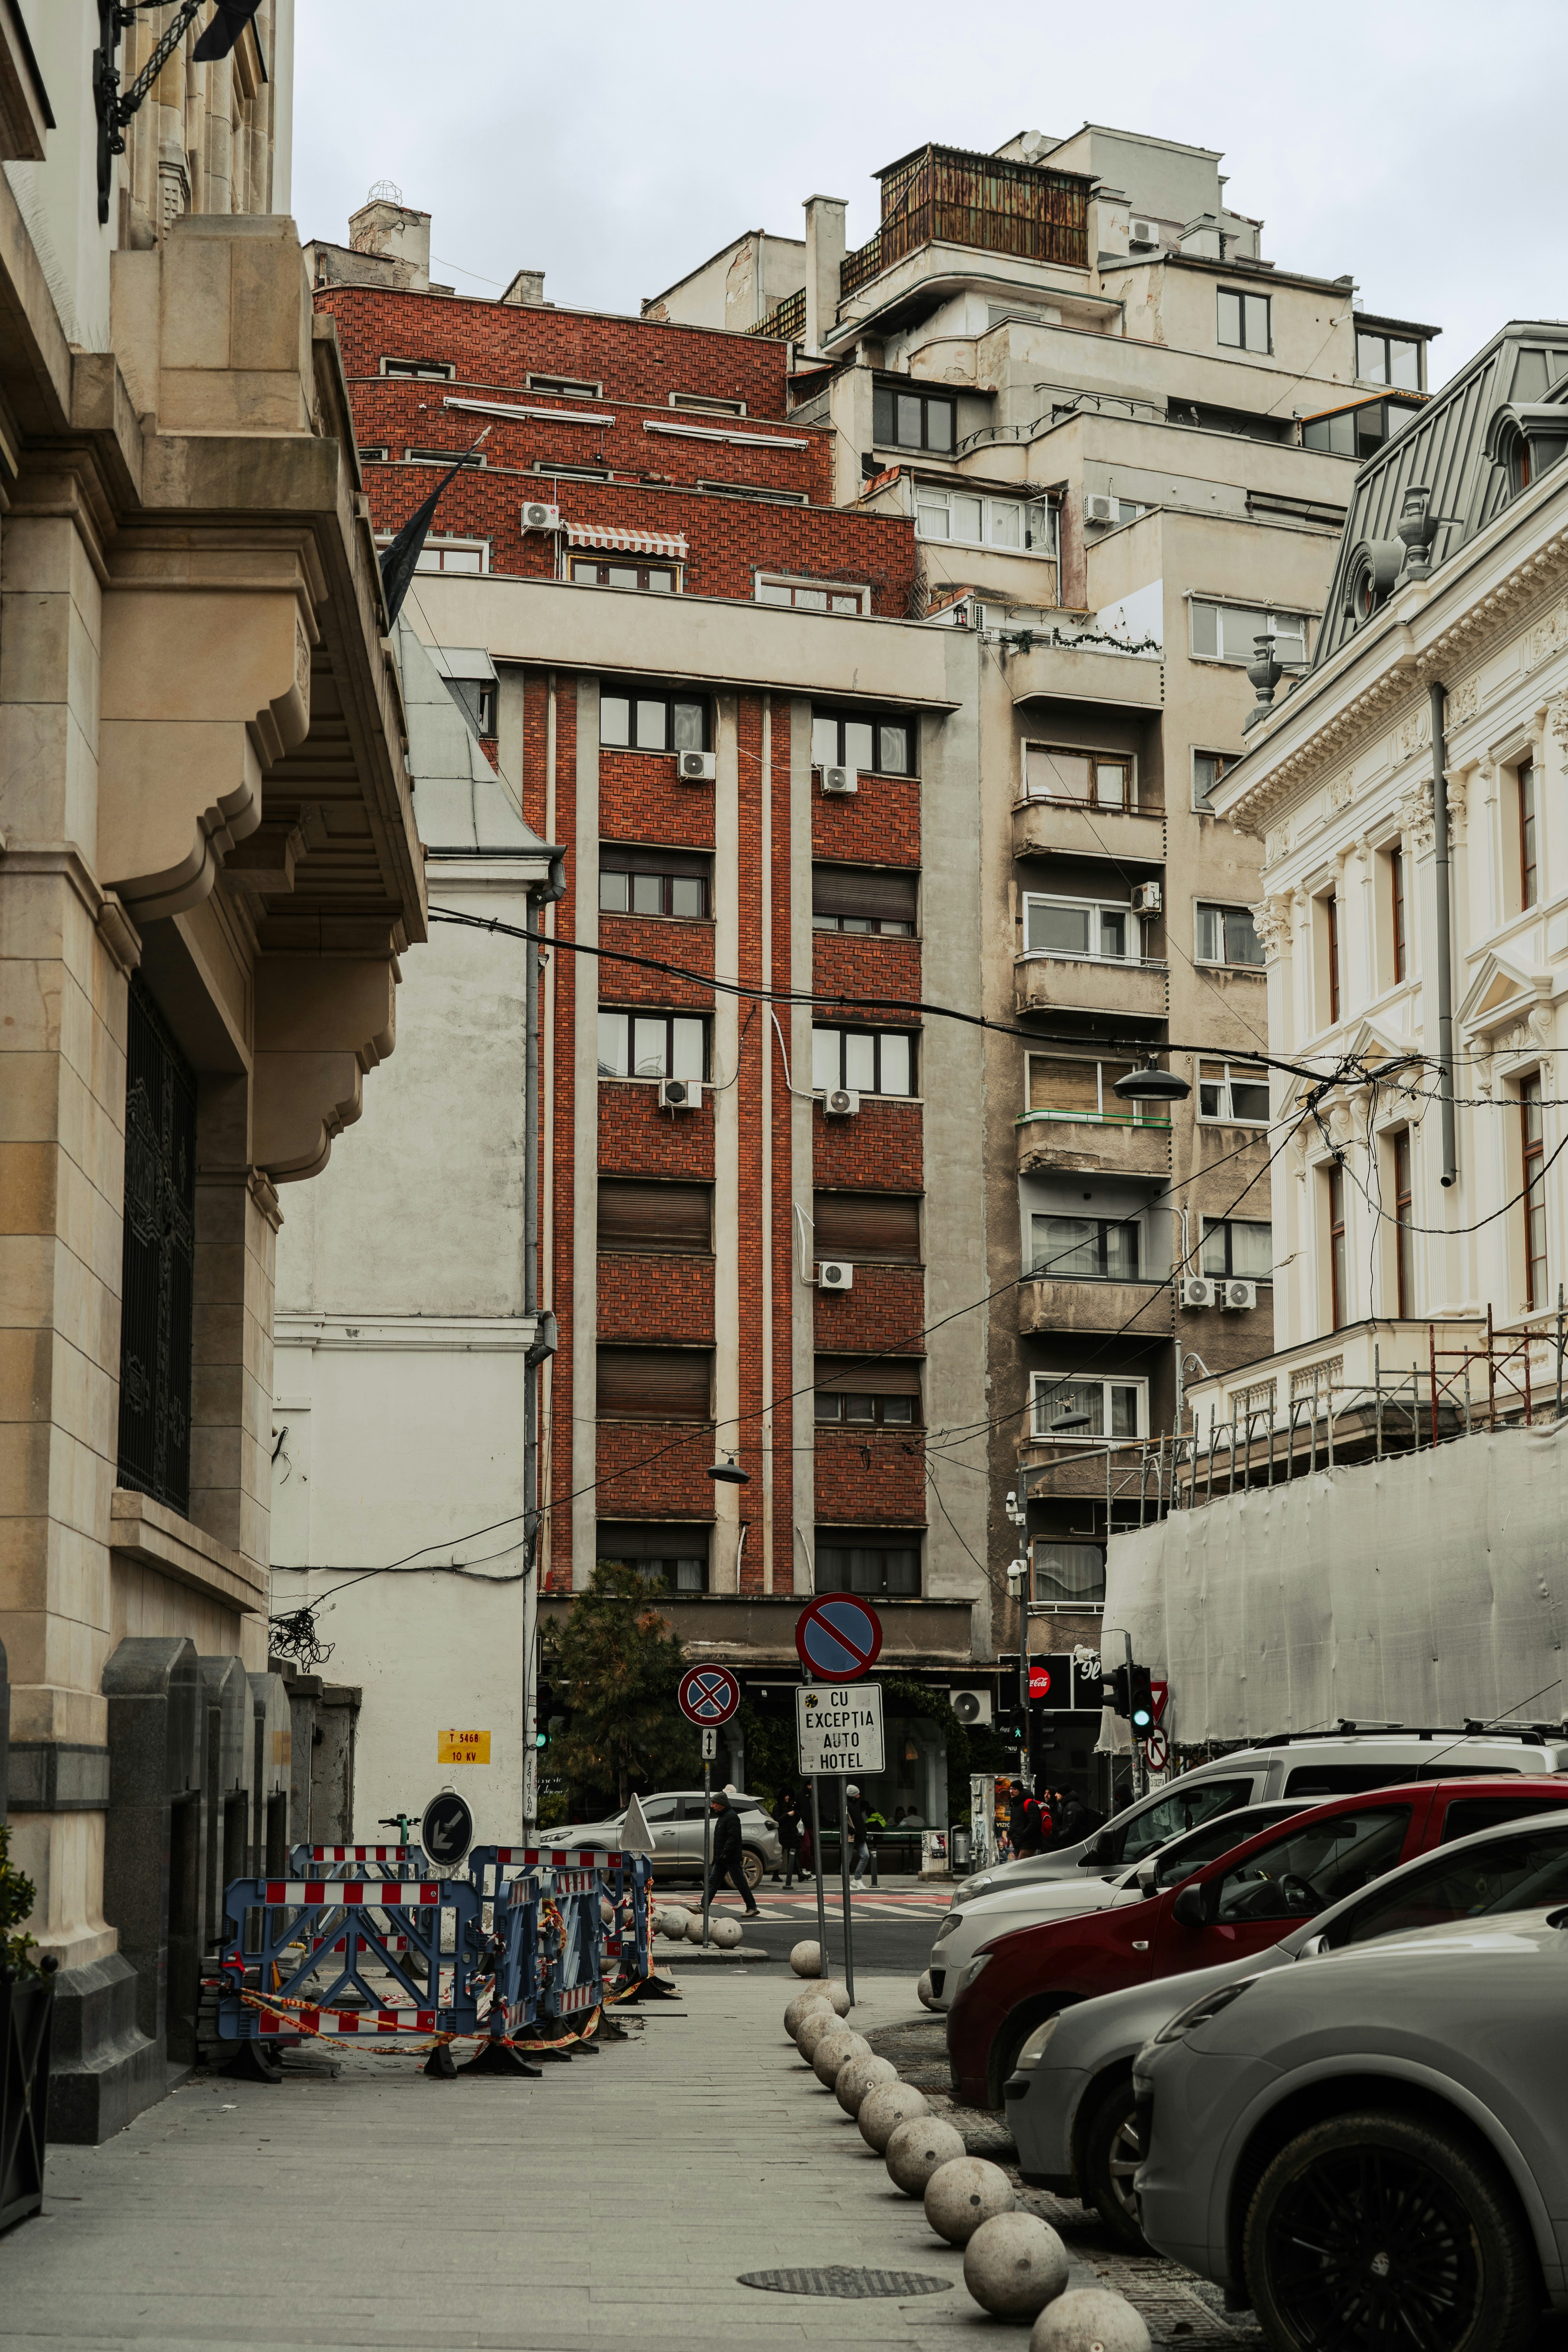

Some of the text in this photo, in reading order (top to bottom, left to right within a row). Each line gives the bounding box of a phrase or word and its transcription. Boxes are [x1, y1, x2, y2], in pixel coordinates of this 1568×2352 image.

[830, 1691, 848, 1706] CU
[806, 1711, 874, 1729] EXCEPȚIA
[450, 1733, 478, 1742] T 5468
[823, 1732, 859, 1748] AUTO
[452, 1752, 476, 1761] 10 KV
[820, 1753, 863, 1769] HOTEL
